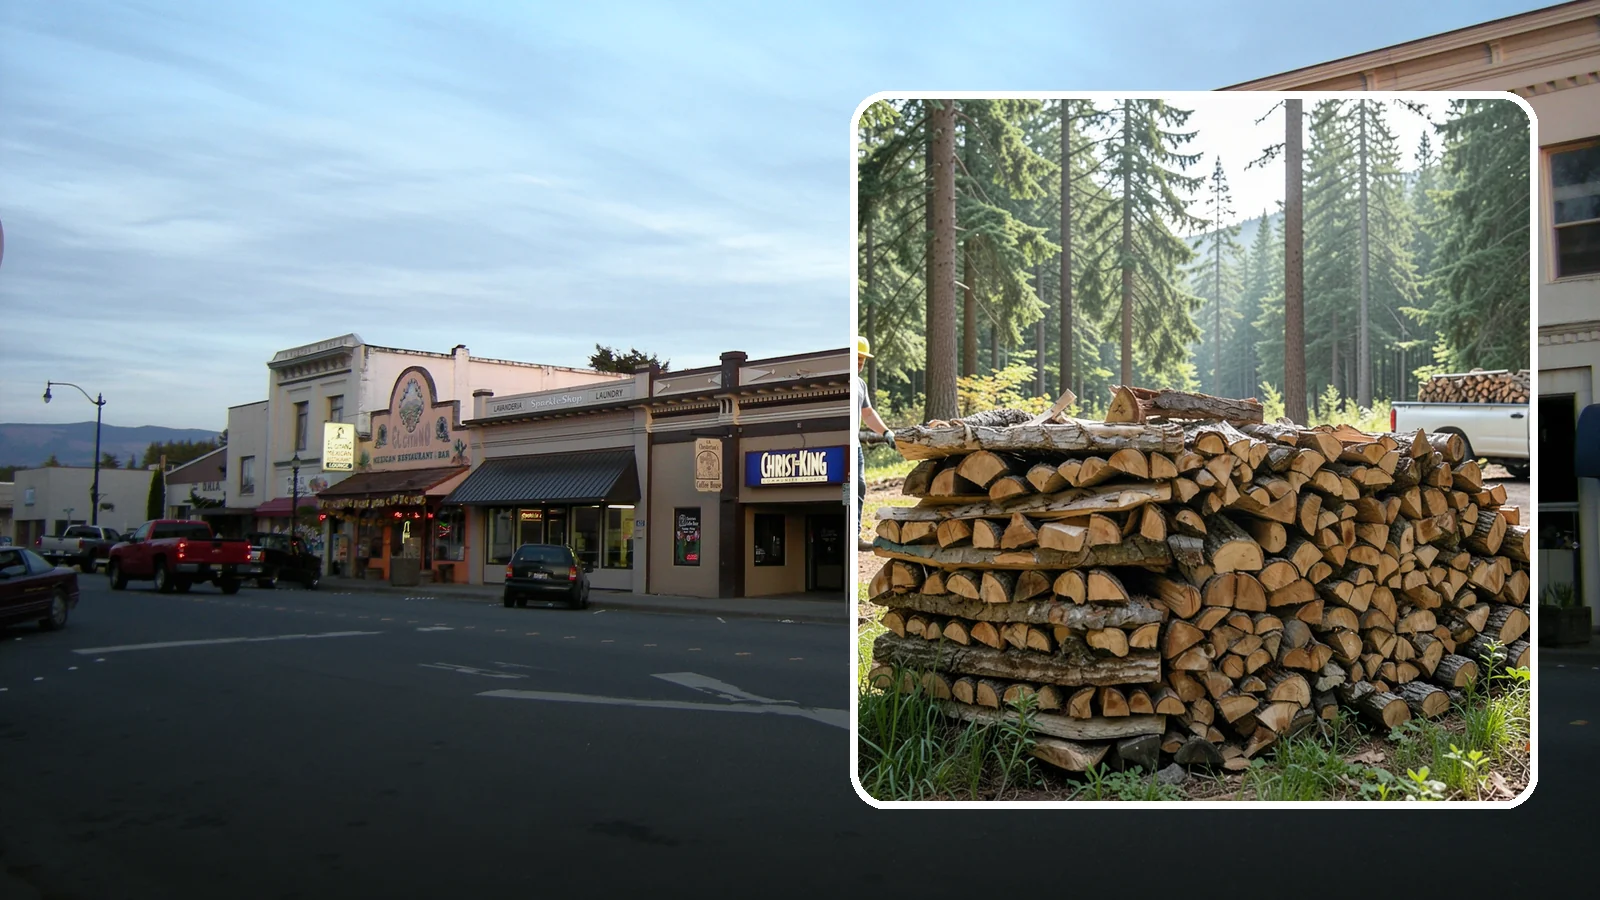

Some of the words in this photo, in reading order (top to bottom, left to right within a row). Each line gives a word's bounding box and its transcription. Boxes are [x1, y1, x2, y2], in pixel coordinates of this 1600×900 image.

[596, 388, 623, 400] LAUNDRY
[494, 402, 522, 412] LAVANDERIA
[530, 396, 560, 409] Sparkle
[560, 394, 582, 404] Shop
[373, 455, 396, 464] MEXICAN
[398, 452, 434, 462] RESTAURANT
[438, 450, 450, 459] BAR
[760, 452, 798, 478] CHRIST
[800, 450, 828, 476] KING
